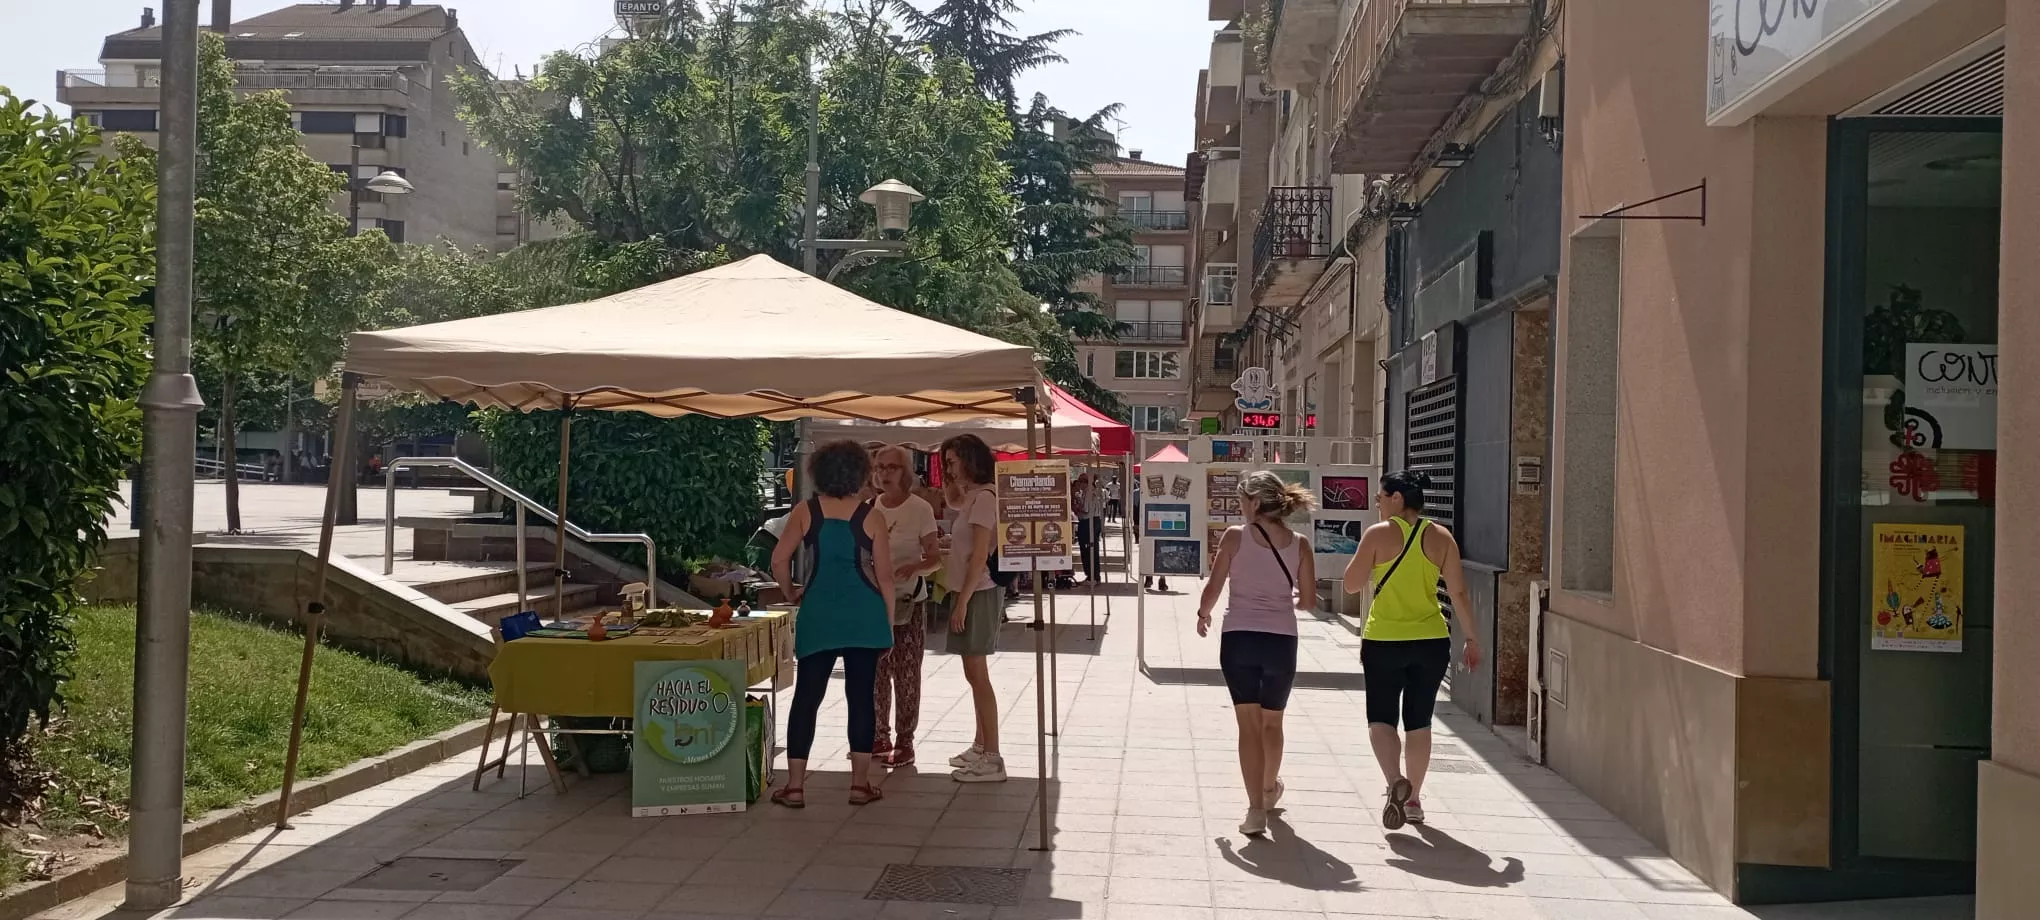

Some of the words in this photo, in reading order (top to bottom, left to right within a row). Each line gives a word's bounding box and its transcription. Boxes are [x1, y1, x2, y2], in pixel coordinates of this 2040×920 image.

[1879, 533, 1958, 545] IMAGINARIA
[657, 679, 693, 697] HACIA
[698, 680, 713, 694] EL
[650, 697, 709, 716] RESIDUO
